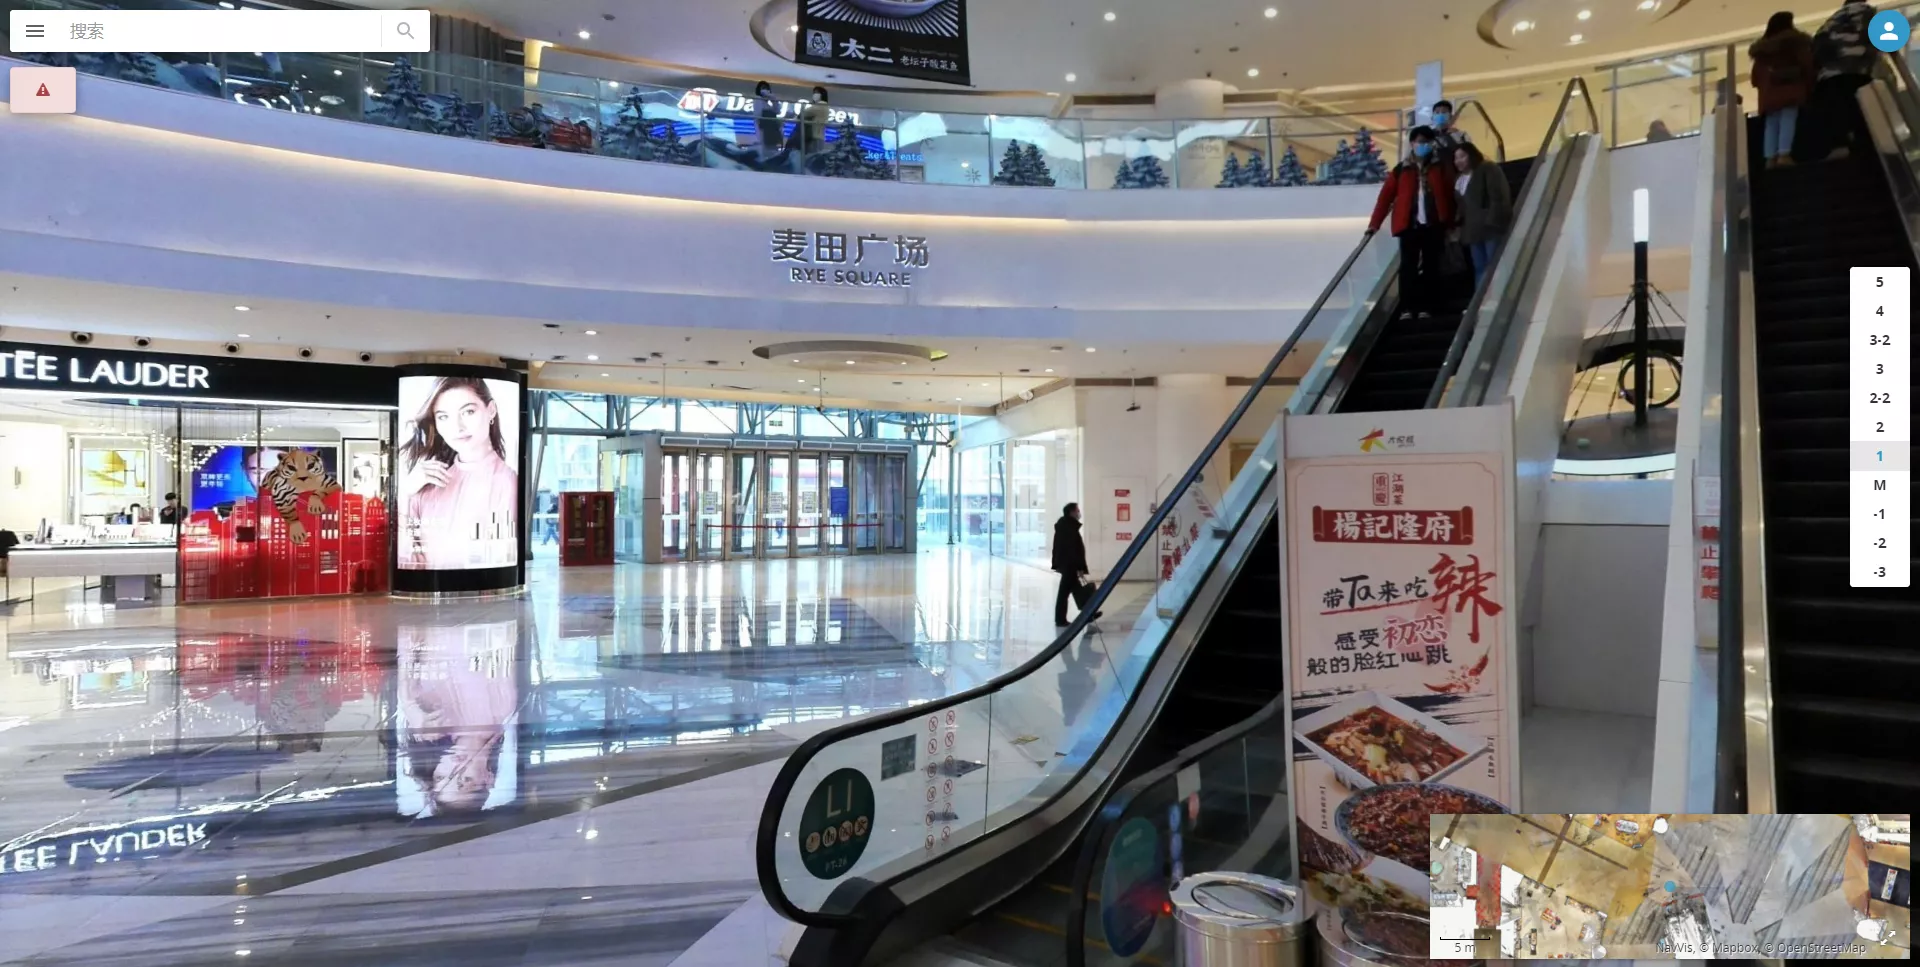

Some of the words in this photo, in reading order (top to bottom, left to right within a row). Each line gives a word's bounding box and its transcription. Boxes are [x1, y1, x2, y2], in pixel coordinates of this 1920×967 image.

[839, 38, 893, 64] 太二
[900, 55, 959, 72] 老坛子酸菜鱼
[726, 92, 788, 118] Day
[771, 228, 929, 268] 麦田广场
[790, 267, 826, 282] RYE
[834, 269, 912, 287] SQUARE
[70, 357, 210, 388] LAUDER
[1392, 472, 1404, 505] 江湖菜
[1333, 511, 1455, 542] 楊記隆府
[1334, 614, 1448, 651] 感受初恋
[1306, 645, 1453, 677] 般的脸红心跳
